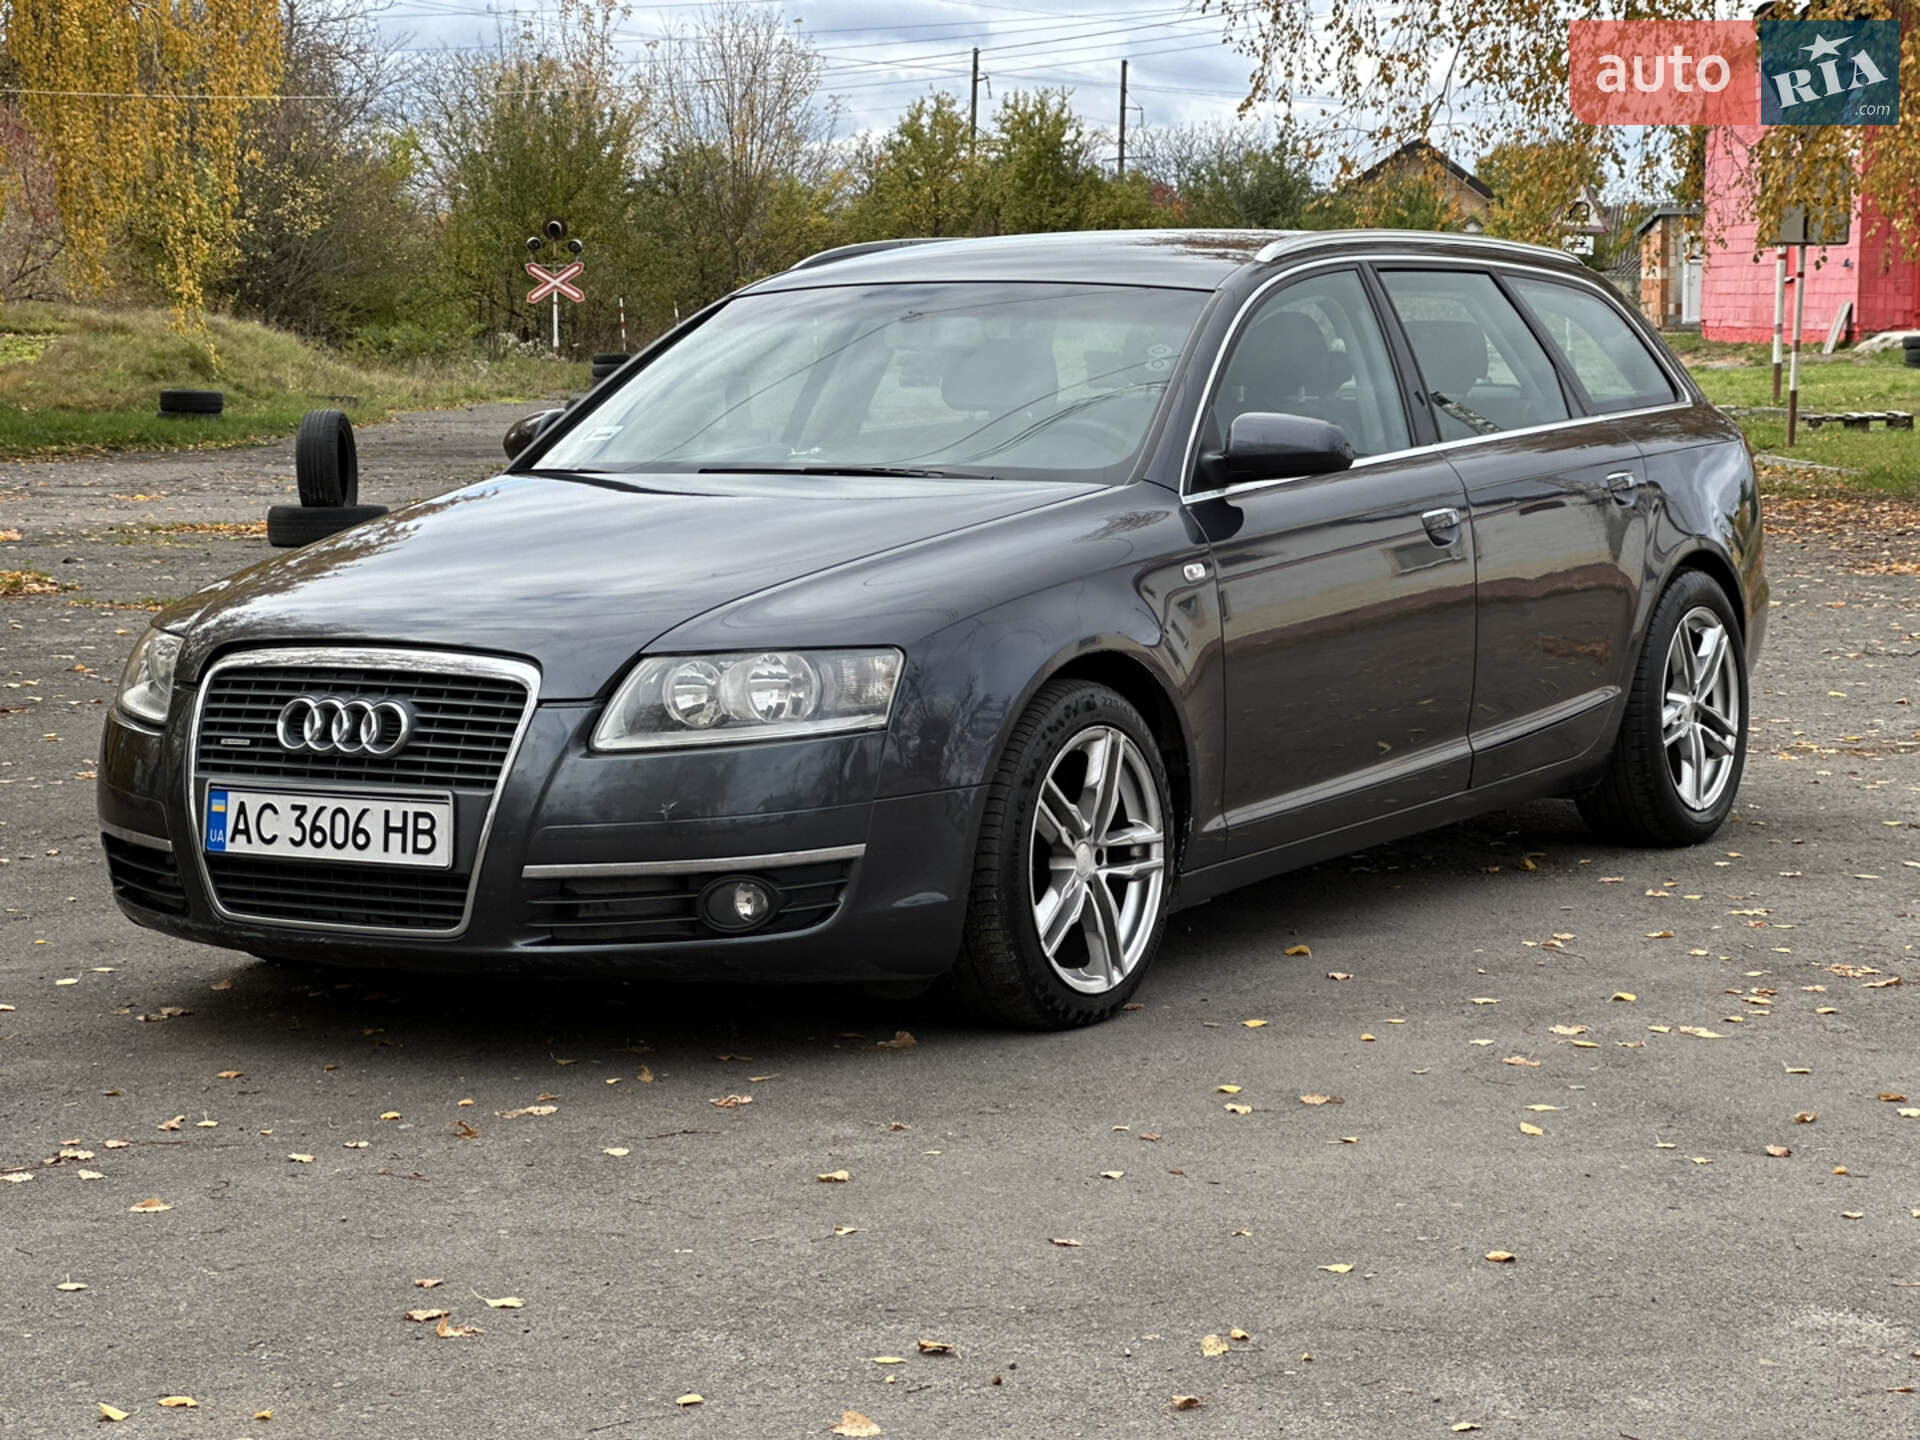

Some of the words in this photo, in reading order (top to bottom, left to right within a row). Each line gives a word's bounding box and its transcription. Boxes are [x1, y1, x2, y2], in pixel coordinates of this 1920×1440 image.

[210, 829, 225, 843] UA
[229, 801, 279, 845] AC
[288, 804, 371, 850] 3606
[383, 809, 437, 855] HB
